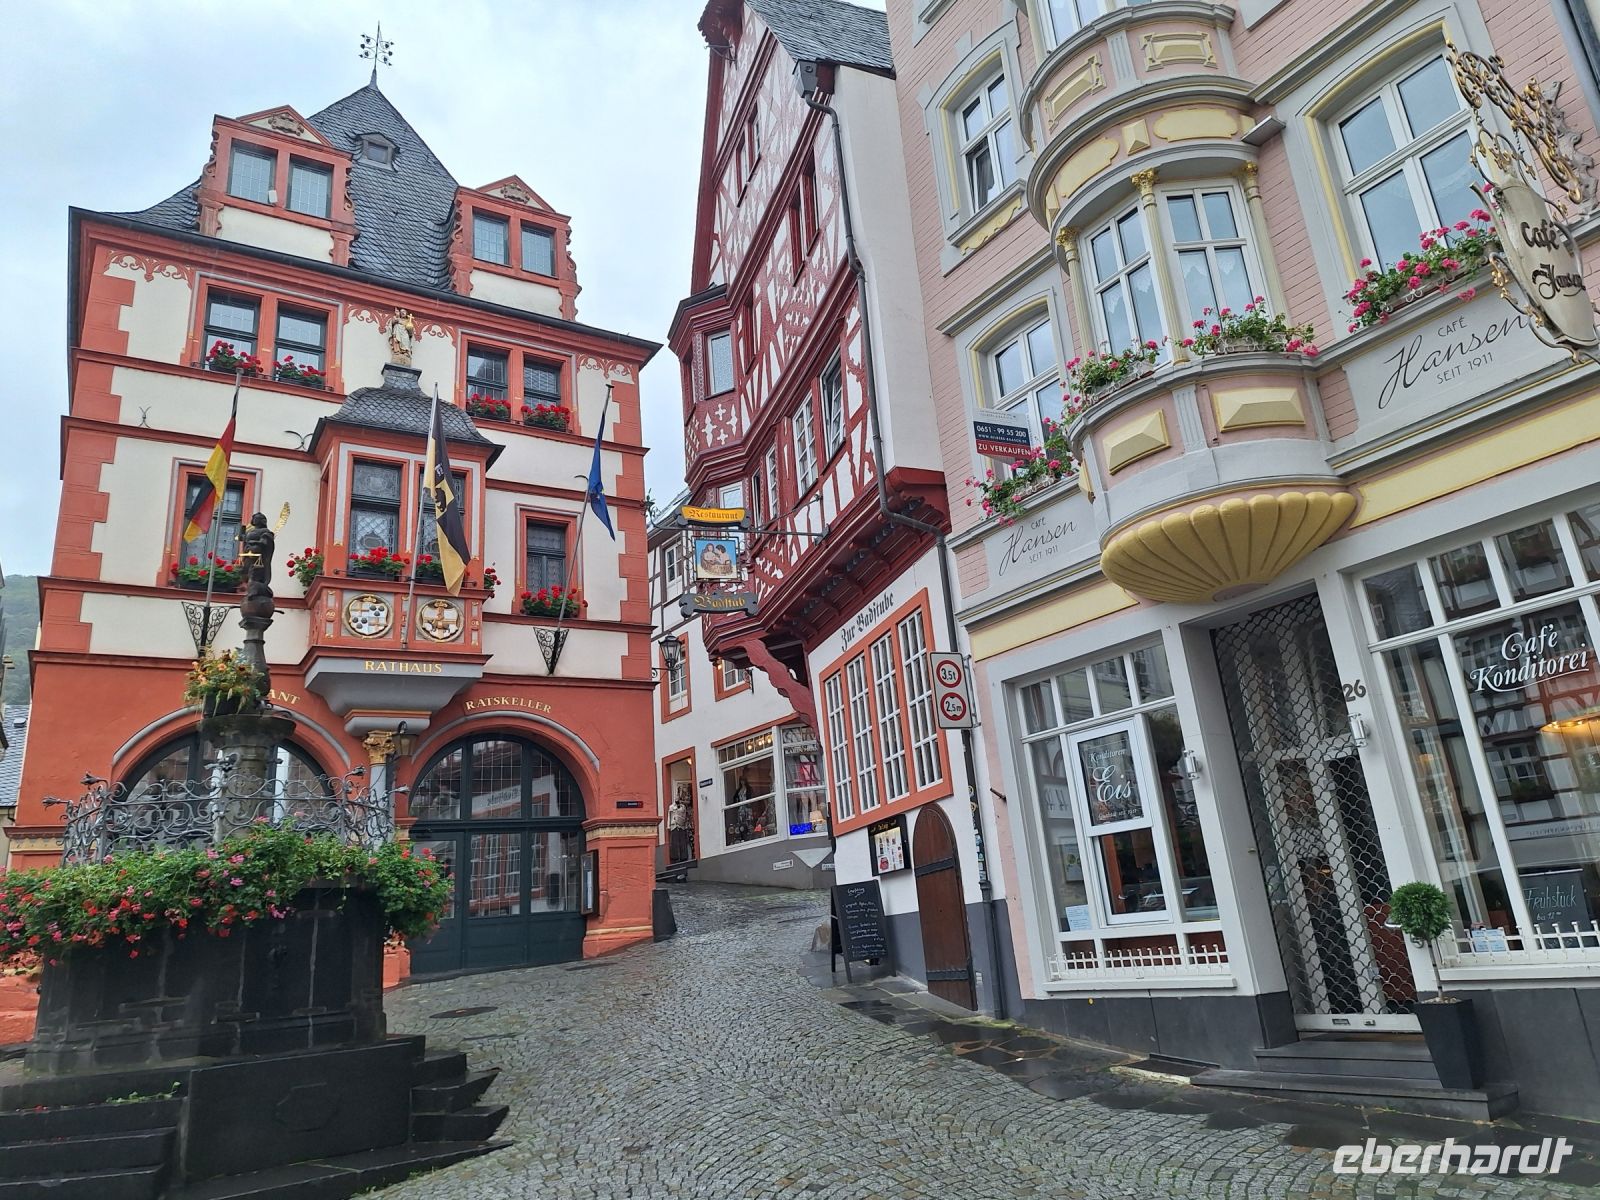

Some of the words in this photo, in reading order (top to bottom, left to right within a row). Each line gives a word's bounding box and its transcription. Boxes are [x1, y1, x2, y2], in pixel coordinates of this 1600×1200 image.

[1521, 218, 1560, 253] Café
[1437, 315, 1468, 338] CAFÉ
[1378, 314, 1529, 410] Hansen
[1436, 364, 1463, 385] SEIT
[1467, 351, 1494, 371] 1911
[976, 425, 992, 433] 0651
[996, 427, 1005, 435] 99
[1014, 430, 1027, 438] 200
[977, 443, 988, 451] ZU
[990, 444, 1031, 456] VERKAUFEN
[689, 509, 738, 519] Restaurant
[998, 521, 1077, 577] Hansen
[1028, 551, 1042, 564] SEIT
[1045, 544, 1059, 556] 1911
[841, 627, 856, 652] Zur
[856, 591, 894, 633] Badstube
[364, 659, 443, 674] RATHAUS
[1470, 642, 1589, 693] Konditorei
[1343, 679, 1367, 703] 26
[465, 696, 552, 714] RATSKELLER
[1092, 764, 1132, 806] Eis
